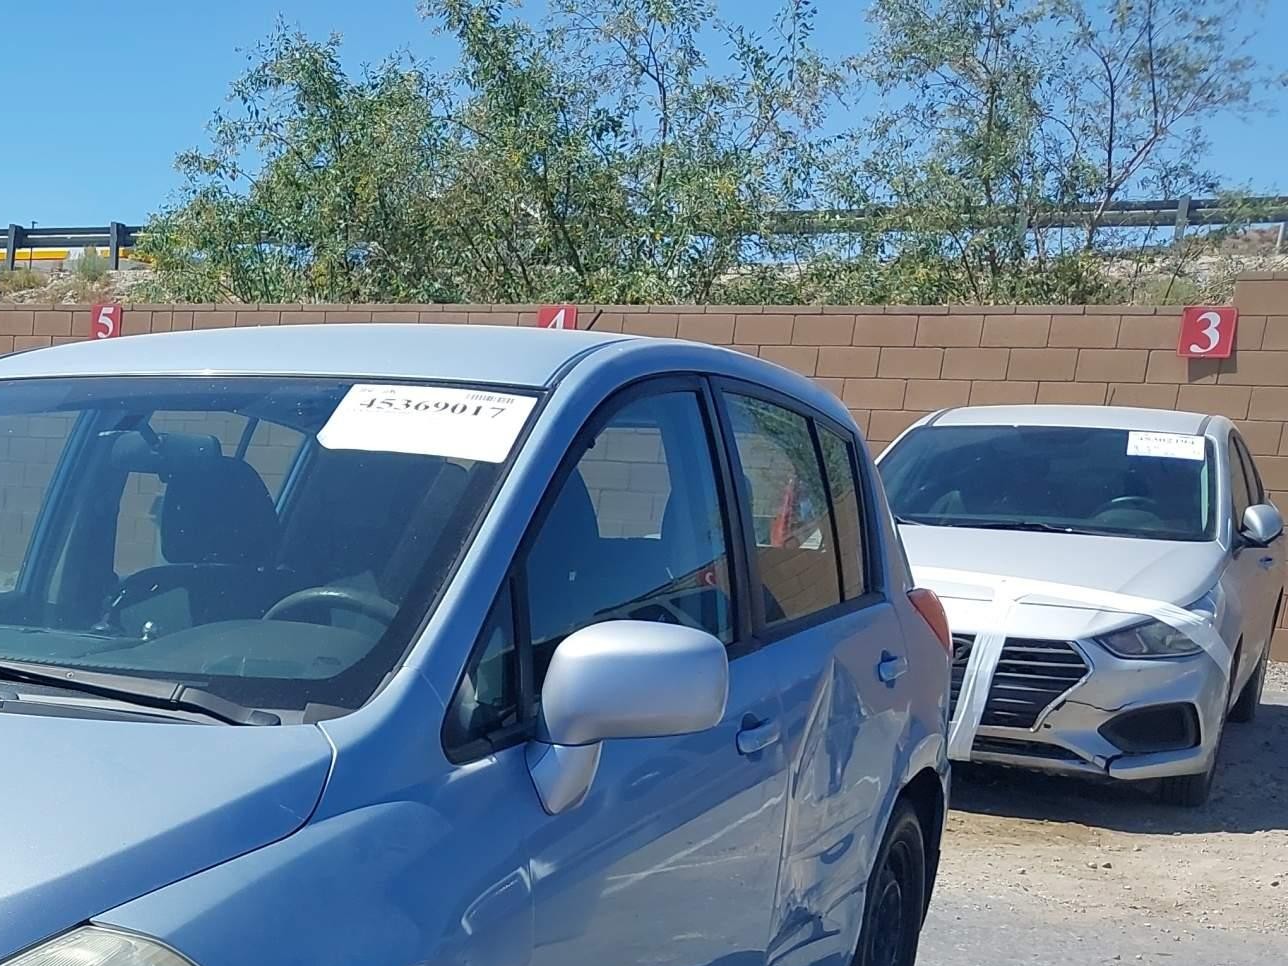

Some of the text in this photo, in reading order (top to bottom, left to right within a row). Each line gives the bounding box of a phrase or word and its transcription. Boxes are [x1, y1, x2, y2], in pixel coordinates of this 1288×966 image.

[97, 307, 114, 338] 5
[1189, 311, 1221, 353] 3
[359, 397, 506, 419] 45369017
